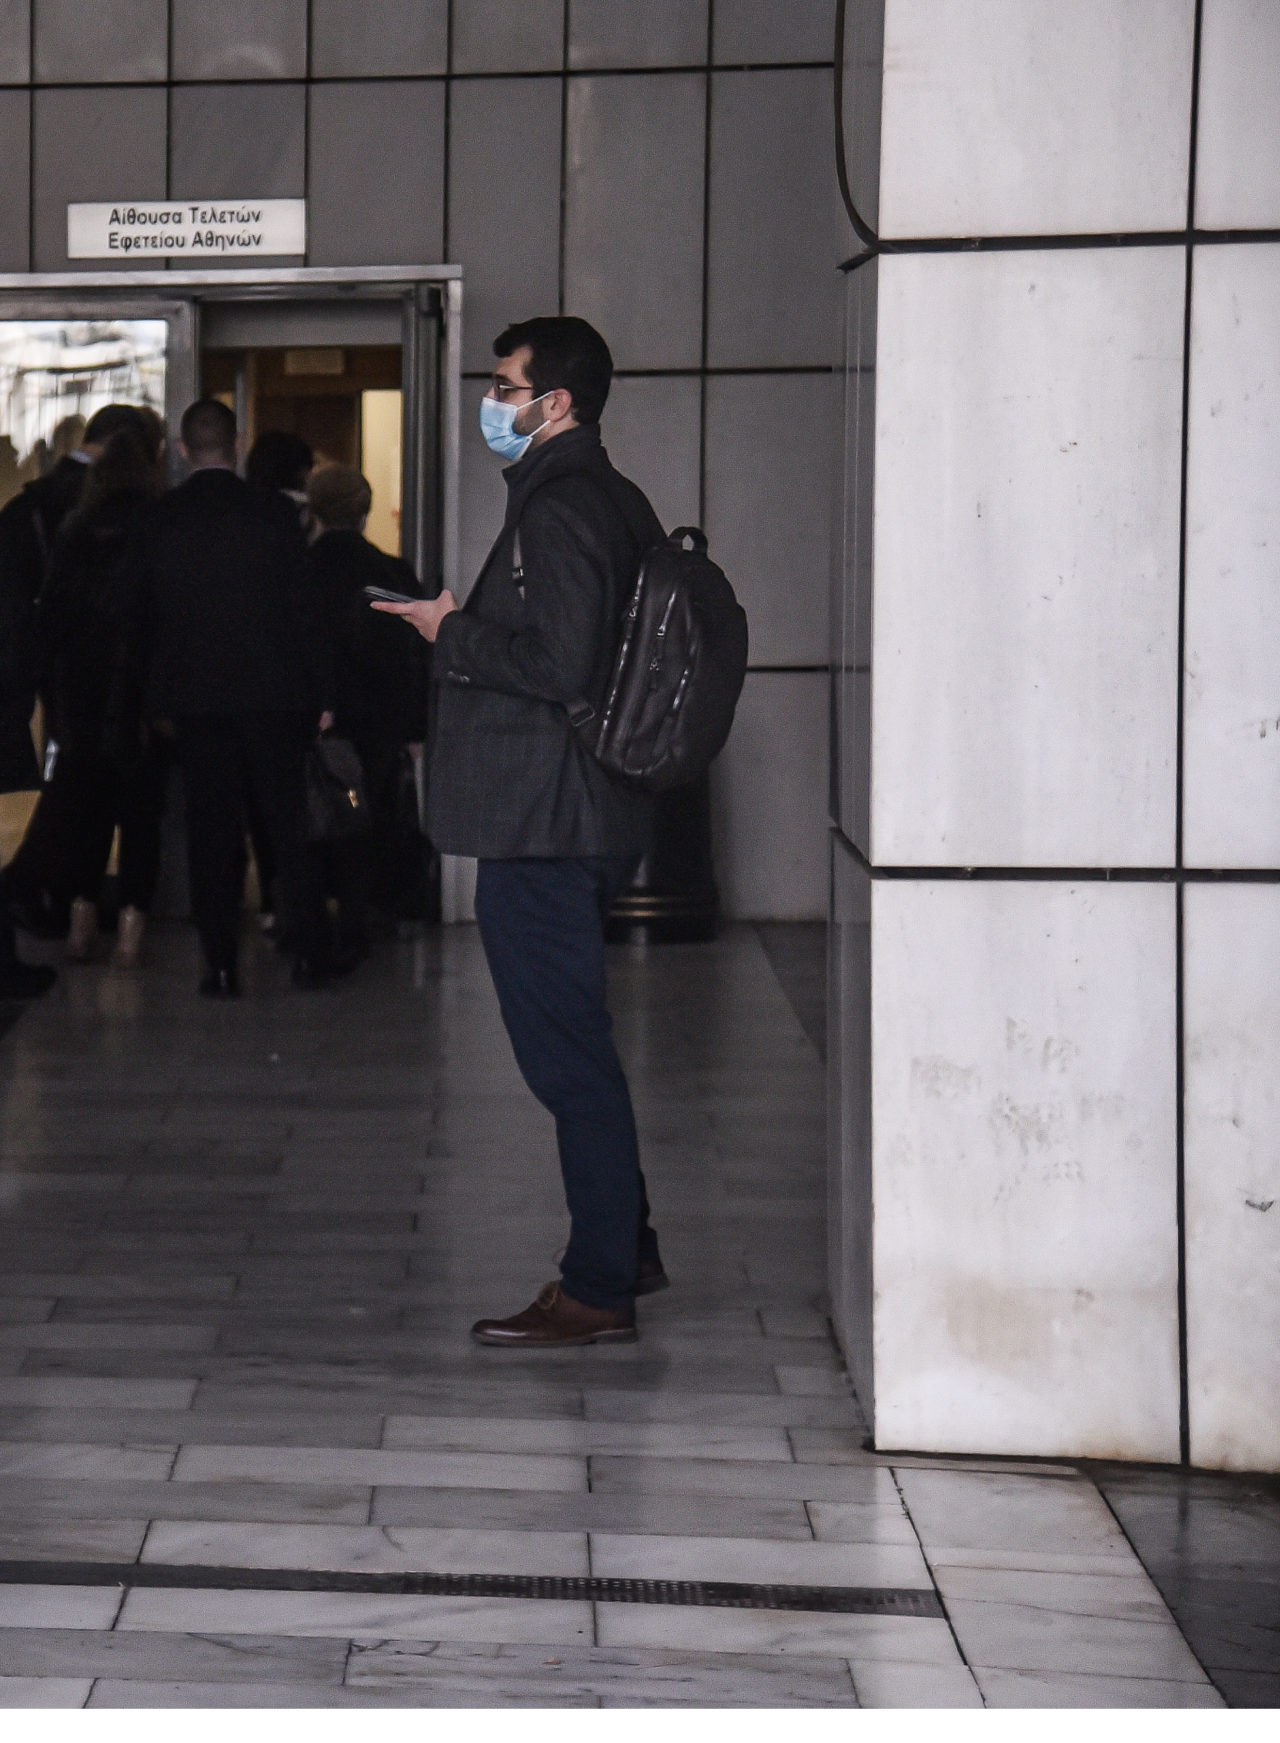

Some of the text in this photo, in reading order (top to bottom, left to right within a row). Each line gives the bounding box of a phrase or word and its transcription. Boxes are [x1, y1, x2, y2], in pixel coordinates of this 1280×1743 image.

[108, 205, 262, 226] Αίθουσα Τελετών
[107, 229, 262, 252] Εφετείου Αθηνών
